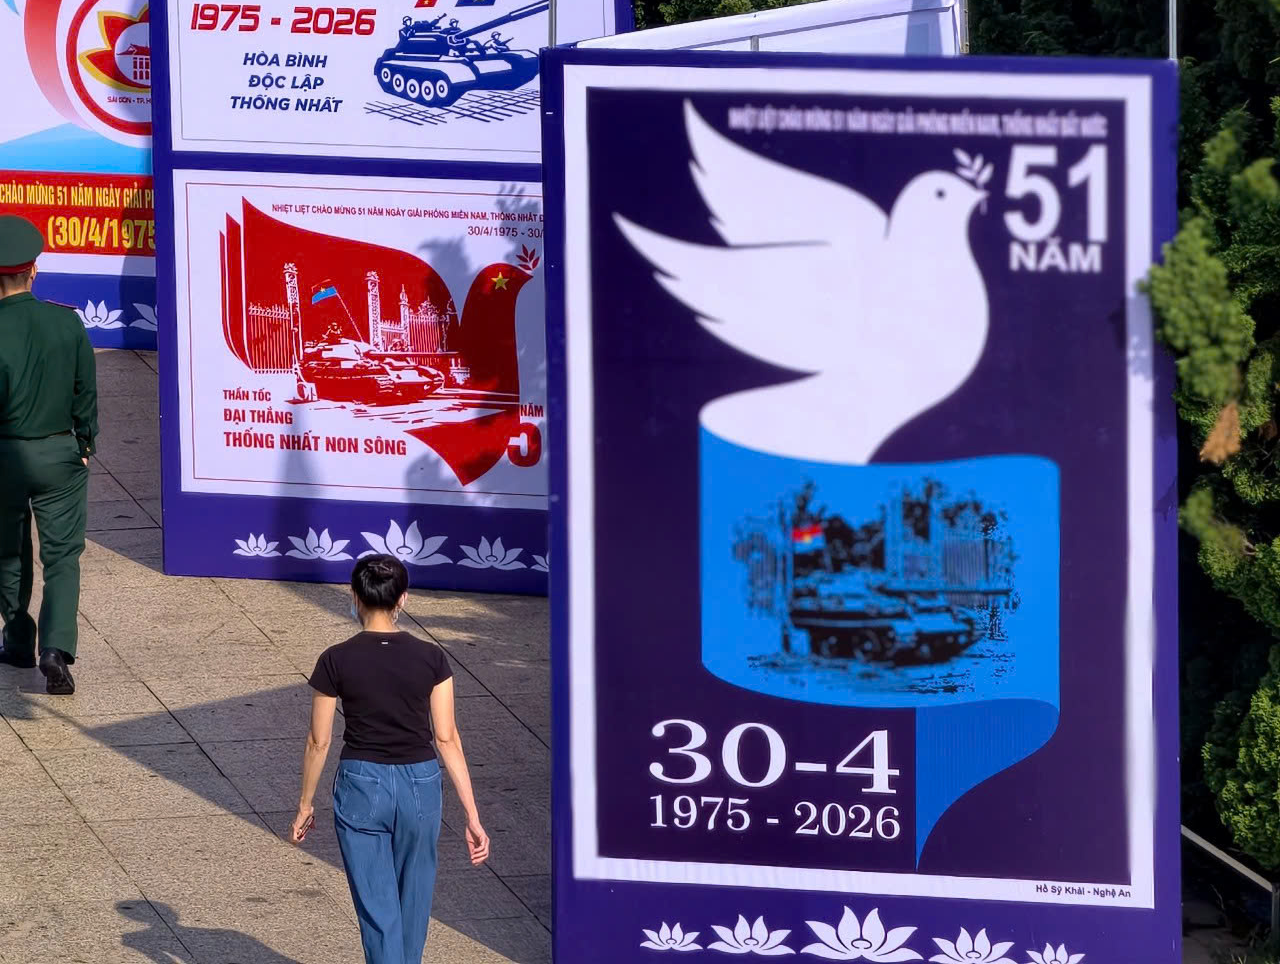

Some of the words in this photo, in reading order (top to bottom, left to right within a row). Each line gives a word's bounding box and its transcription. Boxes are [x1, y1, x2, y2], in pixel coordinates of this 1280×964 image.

[190, 3, 261, 32] 1975
[270, 18, 282, 26] -
[290, 6, 377, 36] 2026
[243, 51, 280, 66] HÒA
[285, 52, 328, 68] BÌNH
[248, 73, 286, 90] ĐỘC
[291, 74, 324, 92] LẬP
[230, 95, 290, 111] THỐNG
[295, 96, 343, 112] NHẤT
[0, 180, 23, 204] CHÀO
[27, 181, 55, 205] MỪNG
[57, 186, 67, 206] 51
[71, 182, 93, 207] NĂM
[96, 184, 120, 207] NGÀY
[123, 182, 142, 208] GIẢI
[1004, 144, 1108, 242] 51
[295, 205, 310, 215] LIỆT
[312, 204, 332, 214] CHÀO
[358, 207, 366, 215] 51
[368, 206, 384, 216] NĂM
[385, 207, 406, 217] NGÀY
[424, 210, 449, 218] PHÓNG
[468, 226, 518, 237] 30/4/1975
[1009, 238, 1102, 272] NĂM
[252, 388, 271, 401] TỐC
[224, 408, 246, 425] ĐẠI
[520, 402, 544, 417] NĂM
[223, 427, 274, 449] THỐNG
[280, 430, 320, 451] NHẤT
[326, 436, 359, 453] NON
[364, 436, 407, 456] SÔNG
[649, 718, 900, 794] 30-4
[649, 794, 751, 831] 1975
[794, 801, 900, 839] 2026
[1093, 888, 1116, 898] Nghệ
[1118, 889, 1131, 897] An
